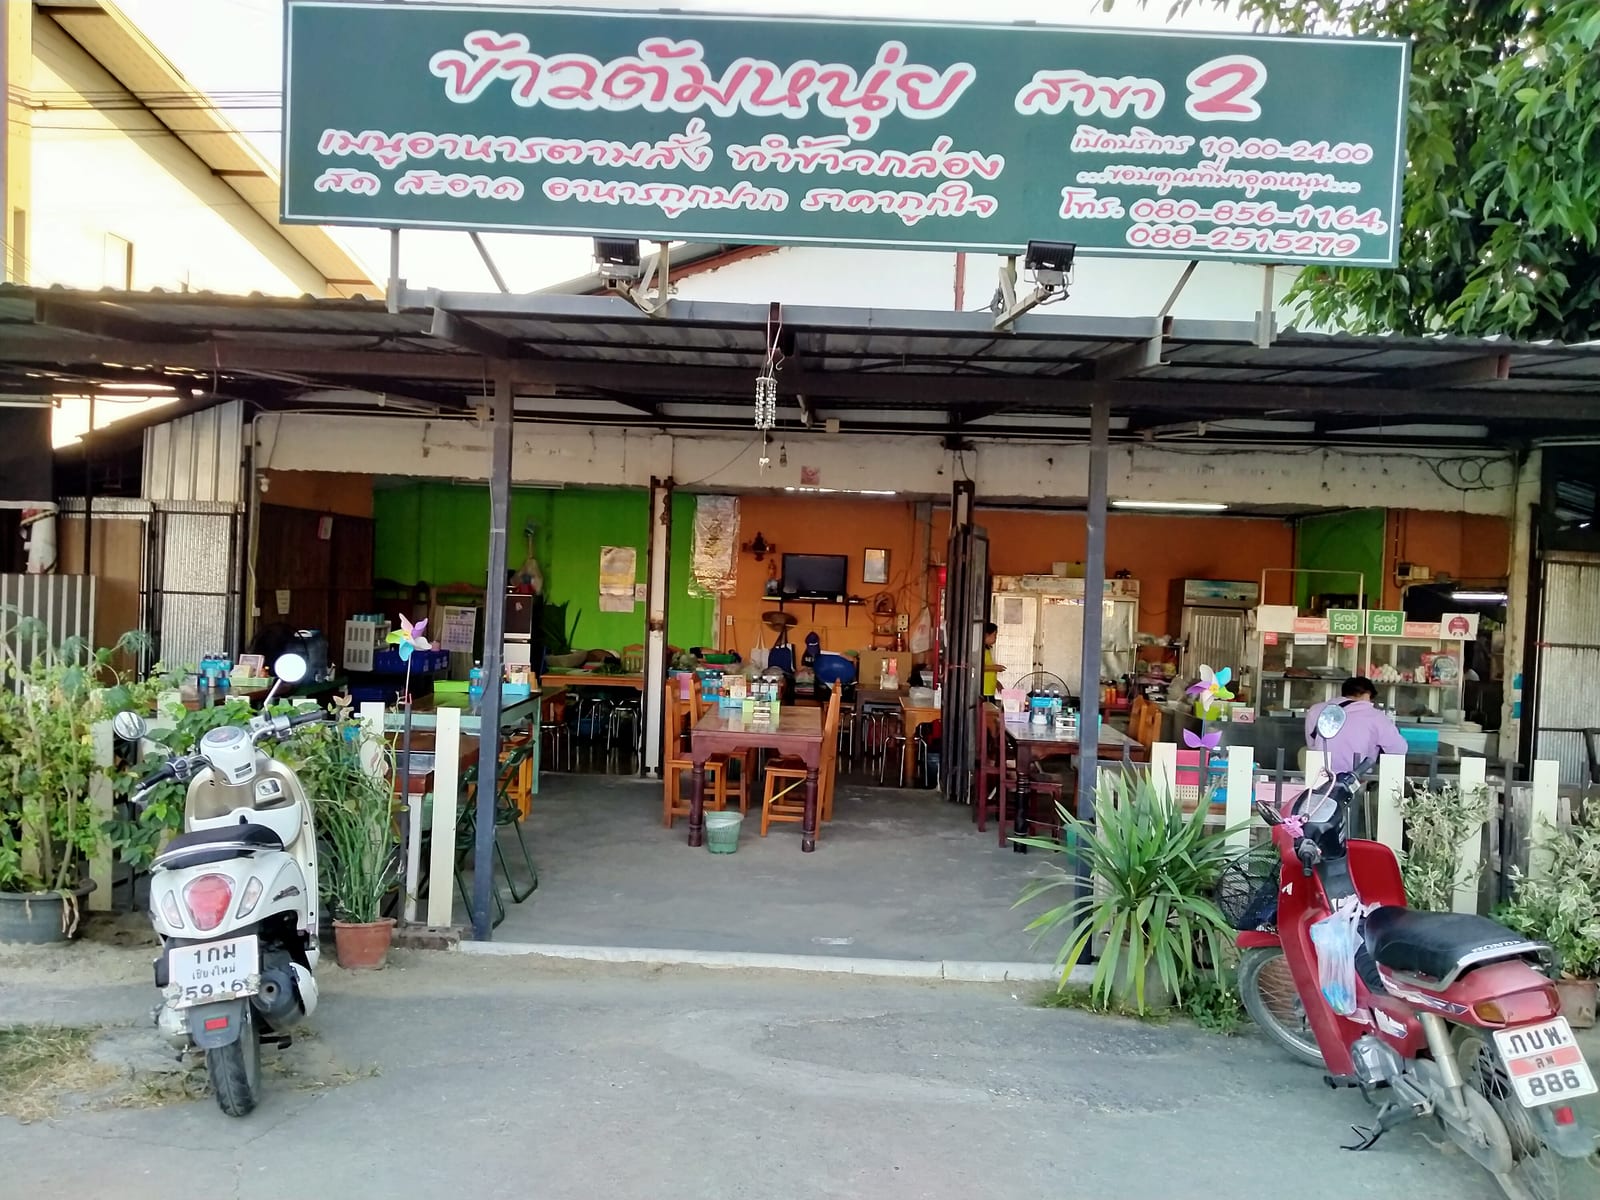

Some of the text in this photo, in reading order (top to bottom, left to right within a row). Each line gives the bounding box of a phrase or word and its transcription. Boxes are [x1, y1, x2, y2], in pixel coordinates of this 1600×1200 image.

[431, 31, 1264, 138] ข้าวต้มหนุ่ย สาขา 2
[320, 120, 1002, 179] เมนูอาหารตามสั่ง ทำข้าวกล่อง
[1072, 127, 1370, 162] เปิดบริการ 10.00-24.00
[316, 170, 996, 223] สด สะอาด อาหารถูกปาก ราคาถูกใจ
[1062, 188, 1386, 232] โทร. 080-856-1164,
[1127, 225, 1358, 255] 088-2515279
[1333, 611, 1358, 623] Grab
[1333, 622, 1358, 631] Food
[1373, 613, 1398, 624] Grab
[1373, 623, 1398, 632] Food
[1527, 1068, 1581, 1097] 886
